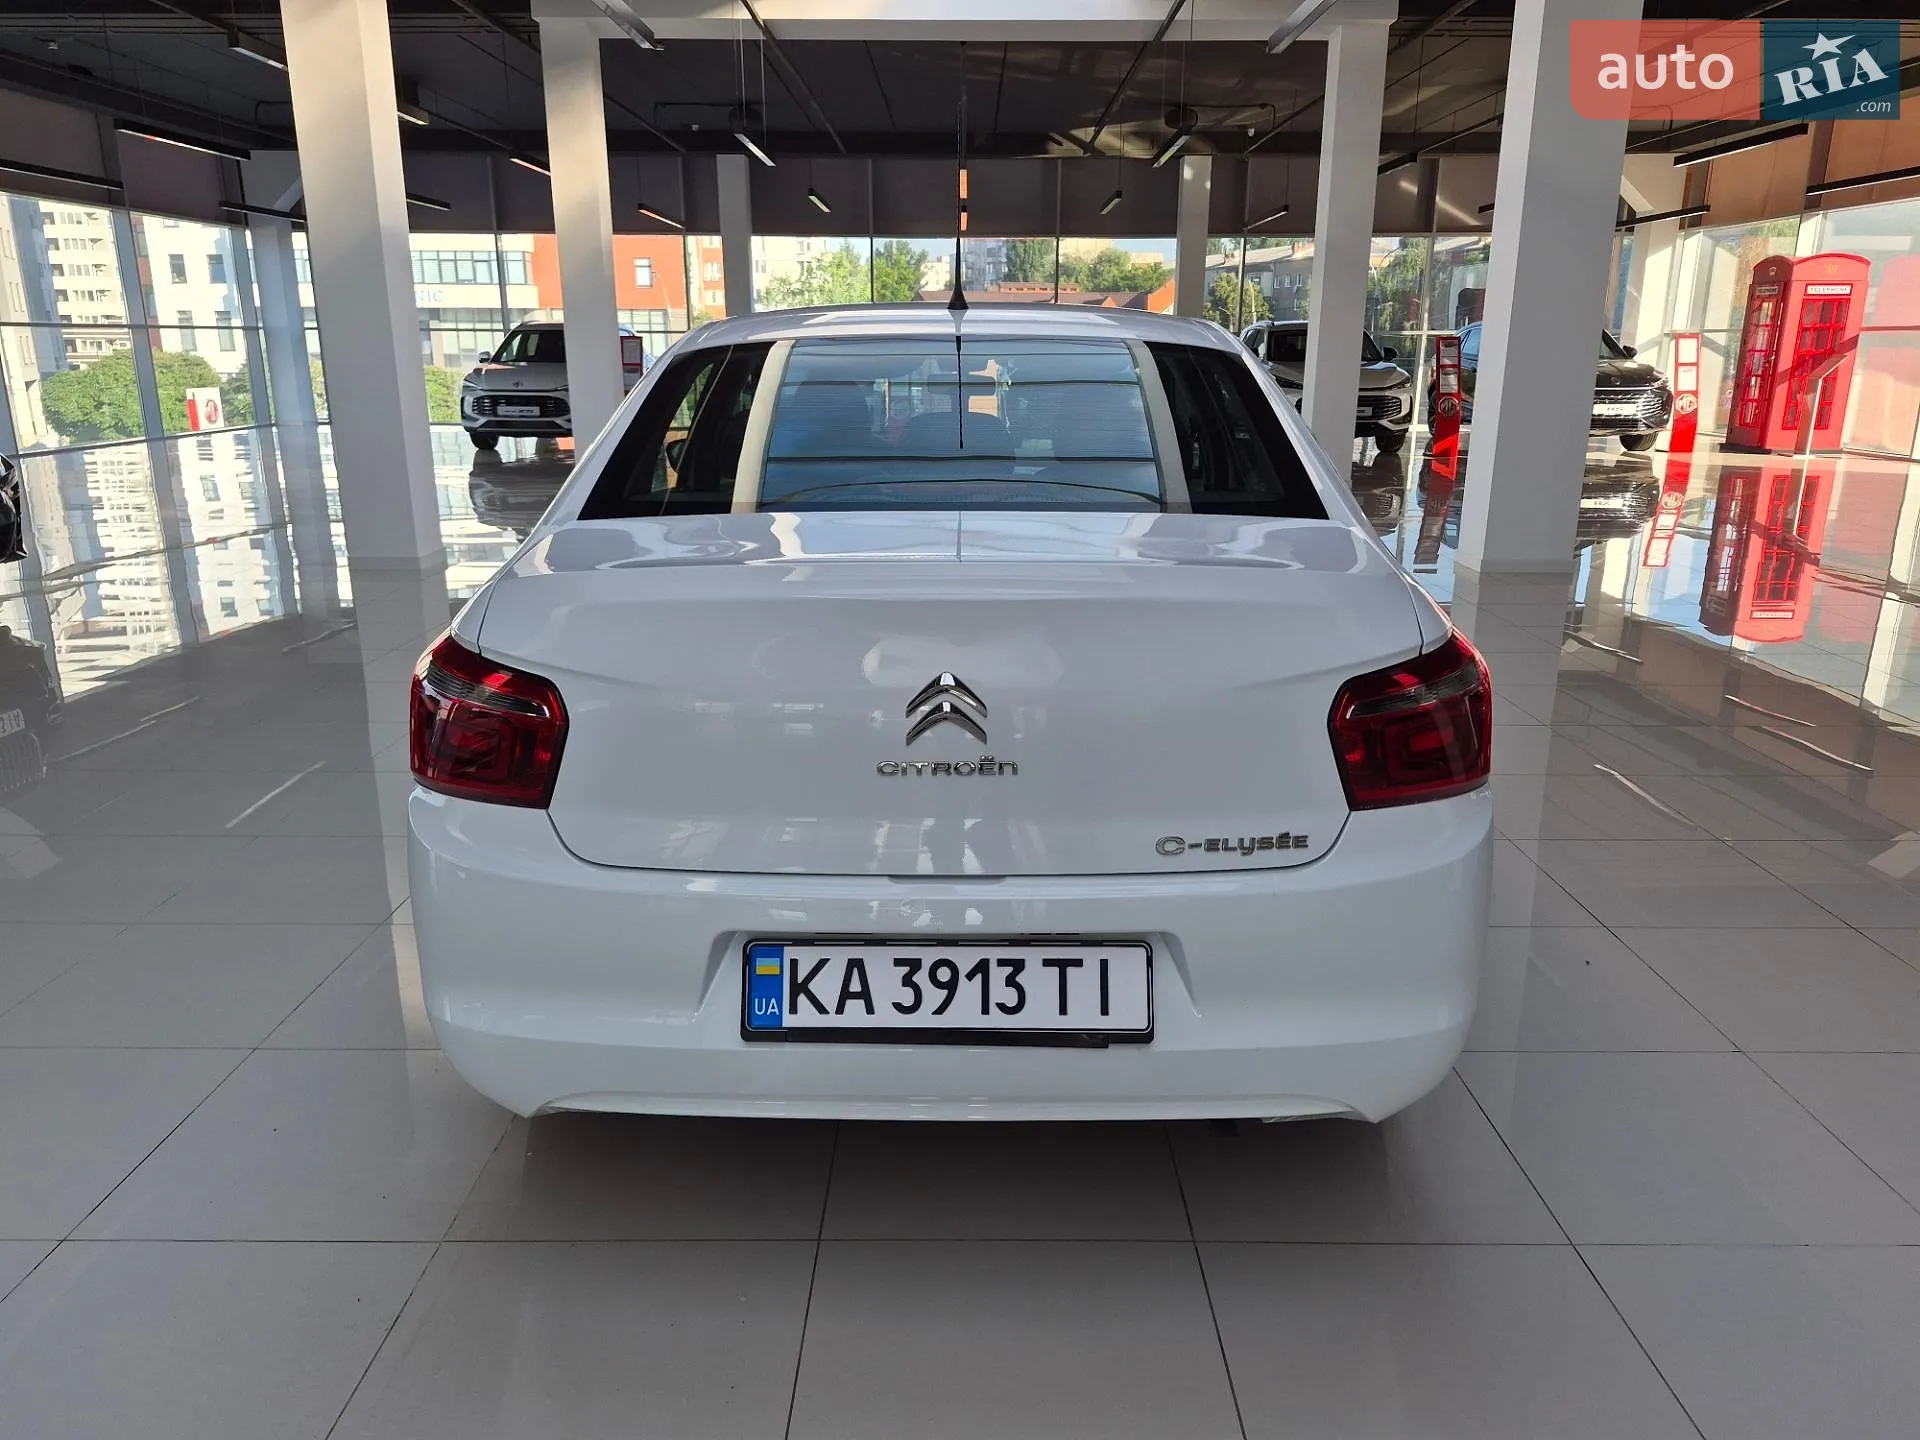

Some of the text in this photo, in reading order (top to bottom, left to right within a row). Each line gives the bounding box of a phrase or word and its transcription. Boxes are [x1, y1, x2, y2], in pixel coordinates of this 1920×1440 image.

[788, 957, 1110, 1016] KA 3913 TI
[754, 998, 780, 1016] UA
